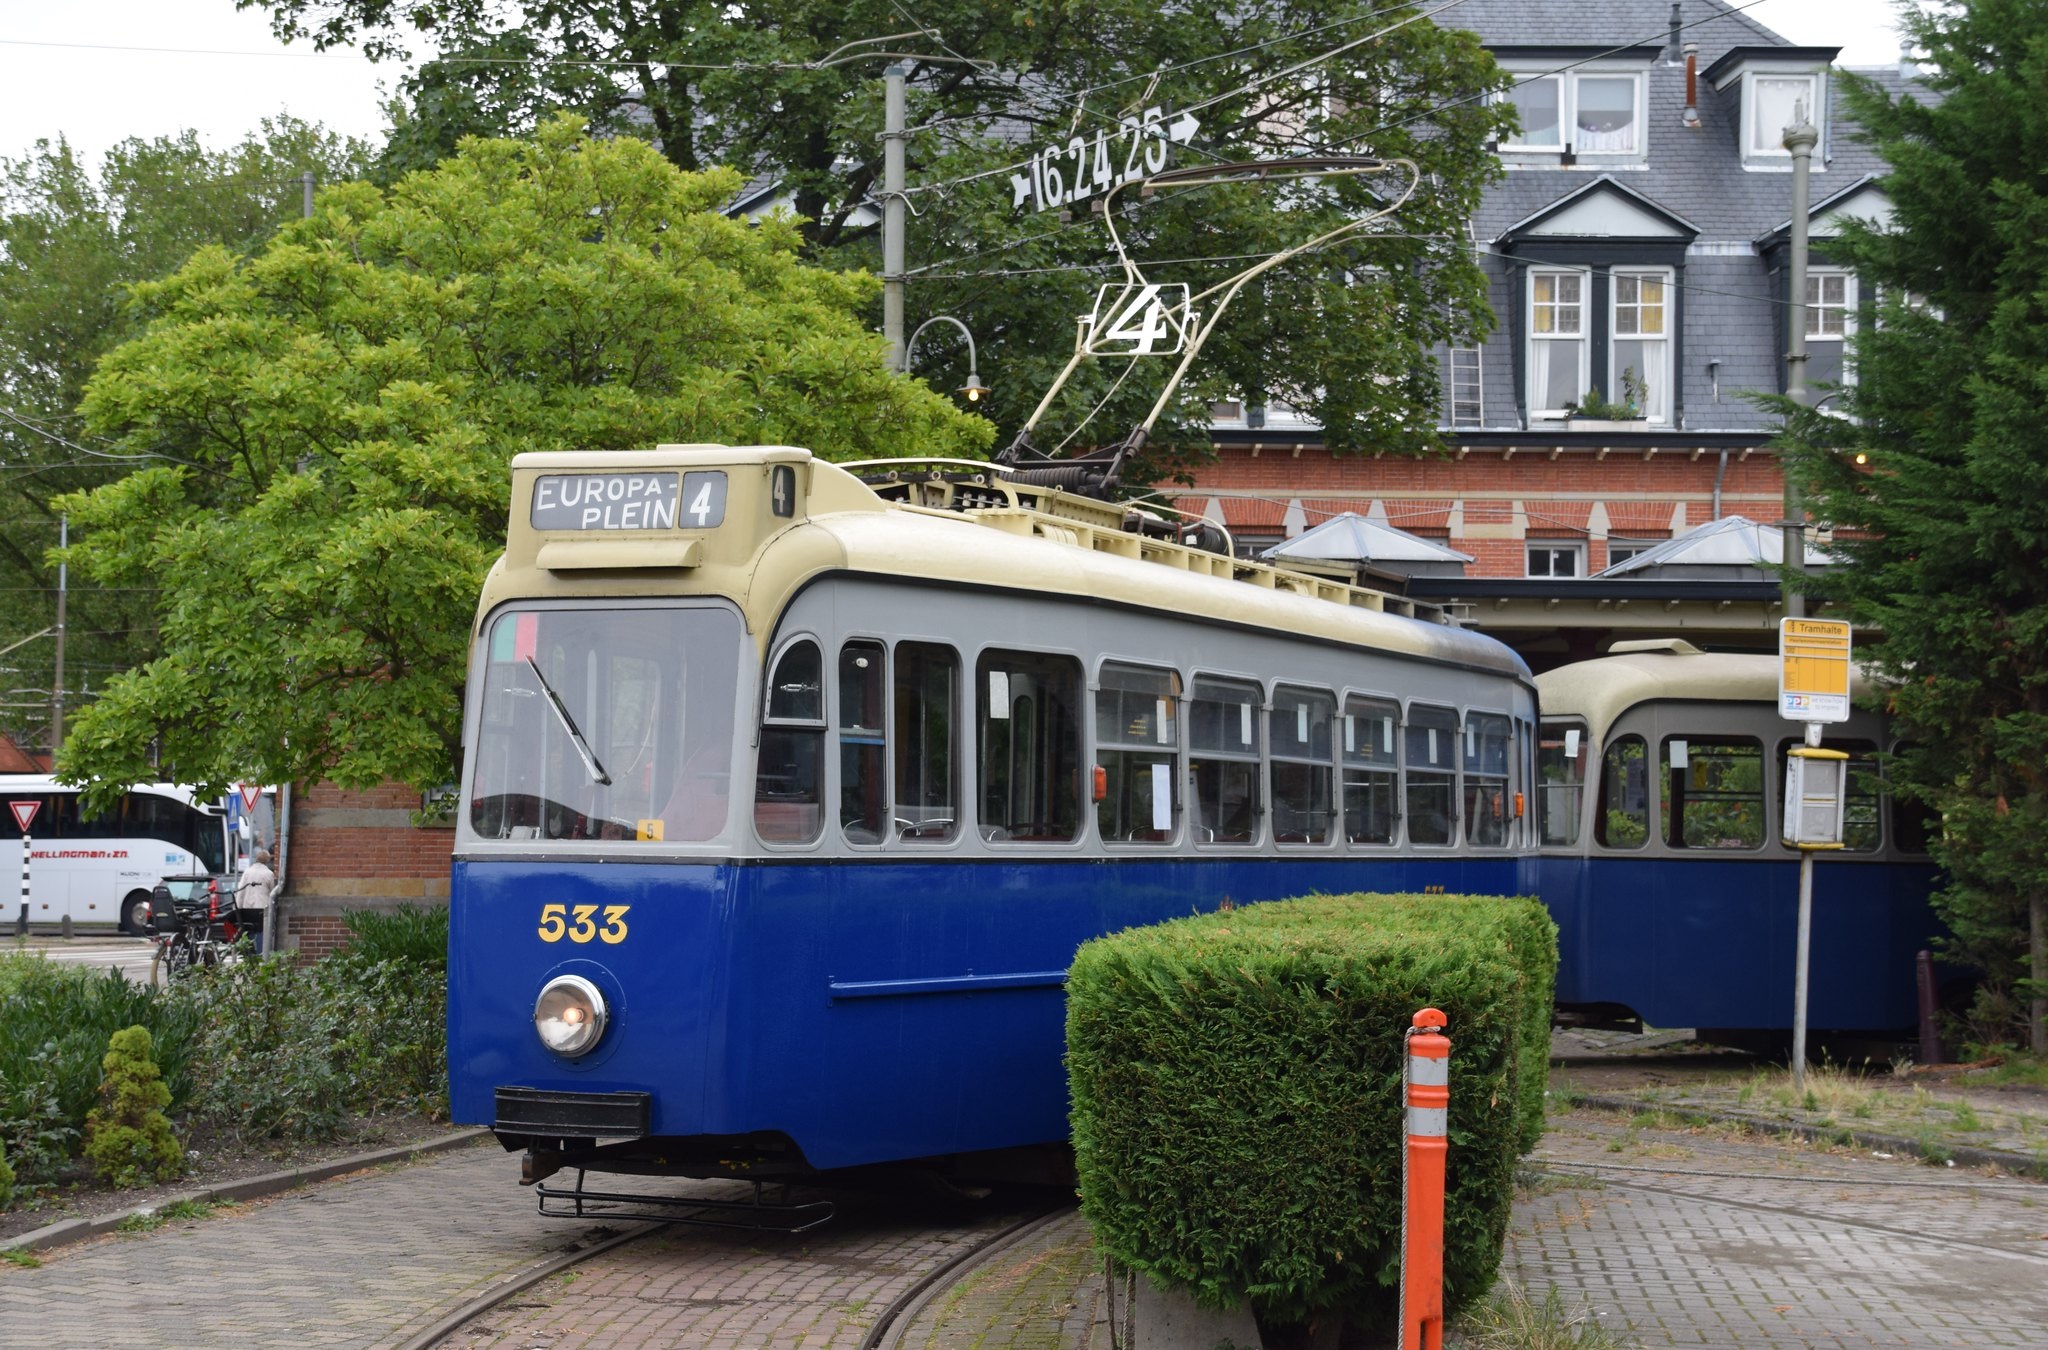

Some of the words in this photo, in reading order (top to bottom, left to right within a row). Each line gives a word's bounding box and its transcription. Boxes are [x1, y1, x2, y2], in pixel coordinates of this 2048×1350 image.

[1105, 285, 1167, 353] 4
[536, 477, 678, 511] EUROPA-
[690, 482, 712, 526] 4
[773, 468, 786, 513] 4
[581, 498, 677, 529] PLEIN
[1799, 623, 1842, 635] Tramhalte
[646, 823, 655, 840] 5
[537, 903, 632, 944] 533
